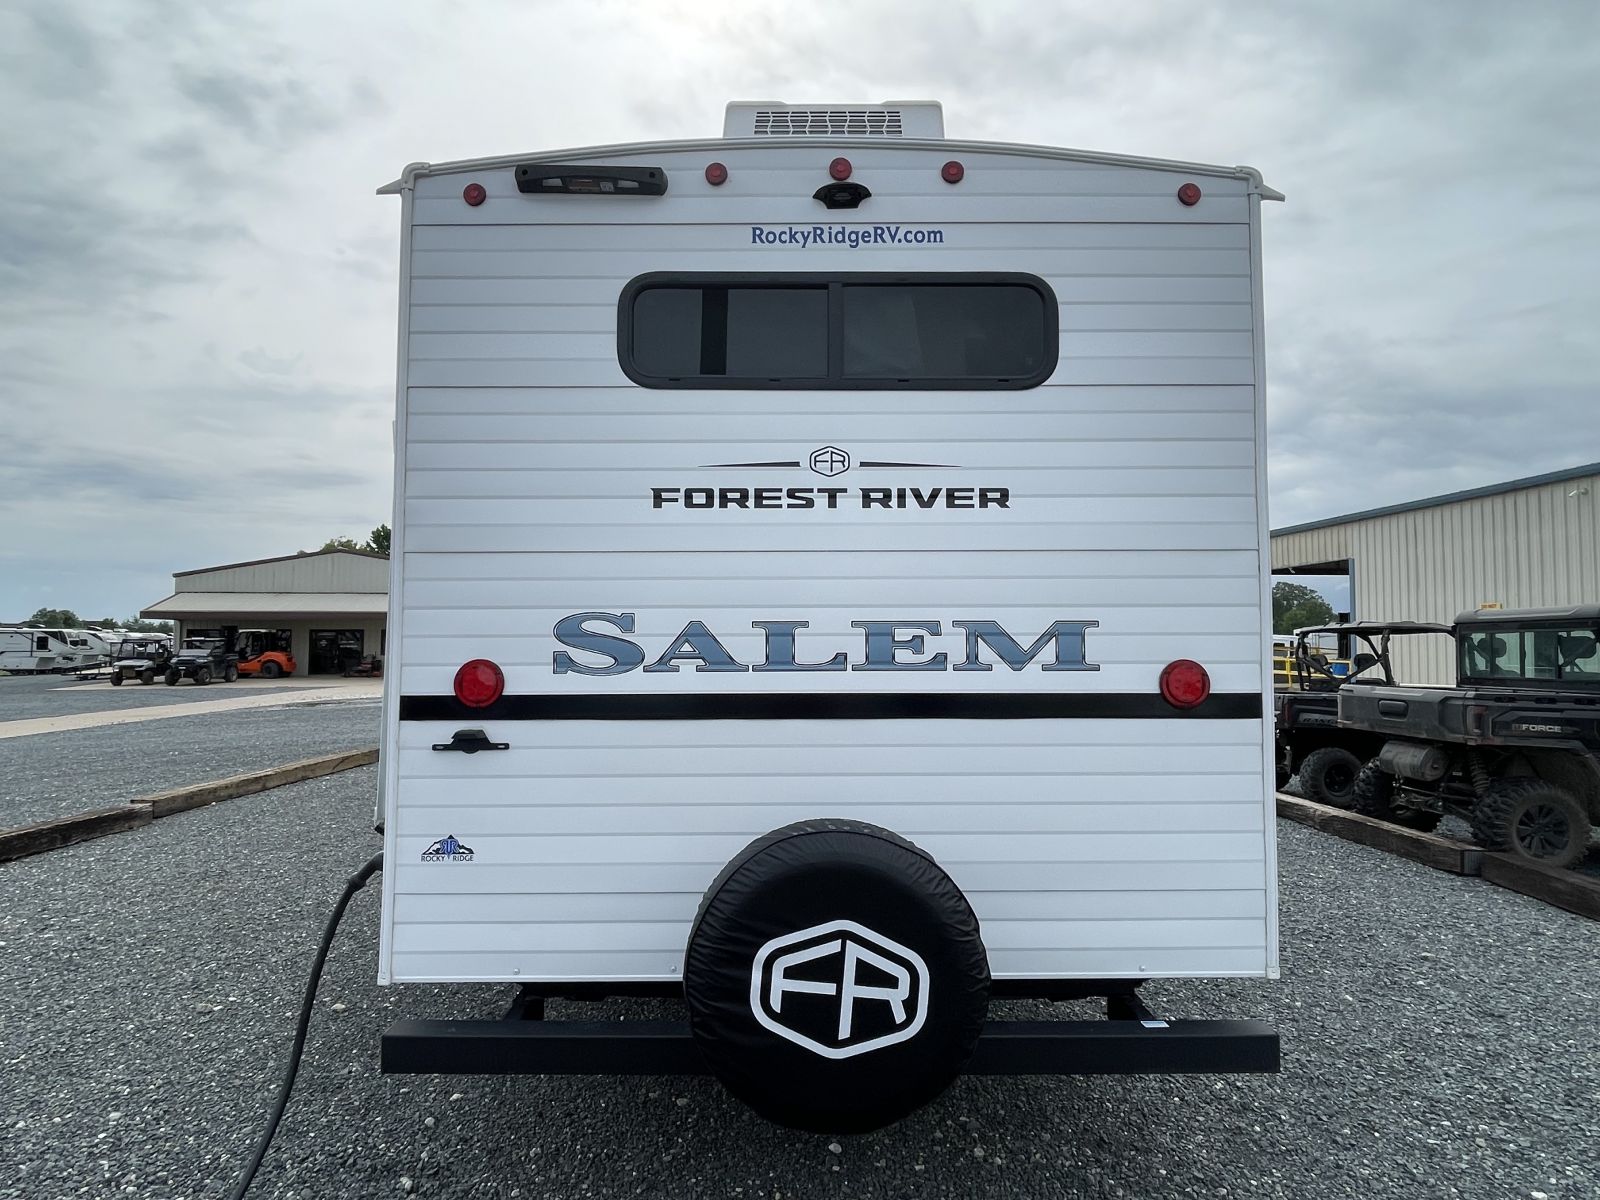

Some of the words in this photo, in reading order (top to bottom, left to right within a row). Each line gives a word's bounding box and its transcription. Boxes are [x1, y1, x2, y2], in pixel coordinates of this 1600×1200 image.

[751, 226, 945, 249] RockyRidgeRV.com
[650, 487, 848, 509] FOREST
[858, 487, 1011, 509] RIVER
[553, 611, 1100, 676] SALEM
[769, 938, 907, 1041] FR
